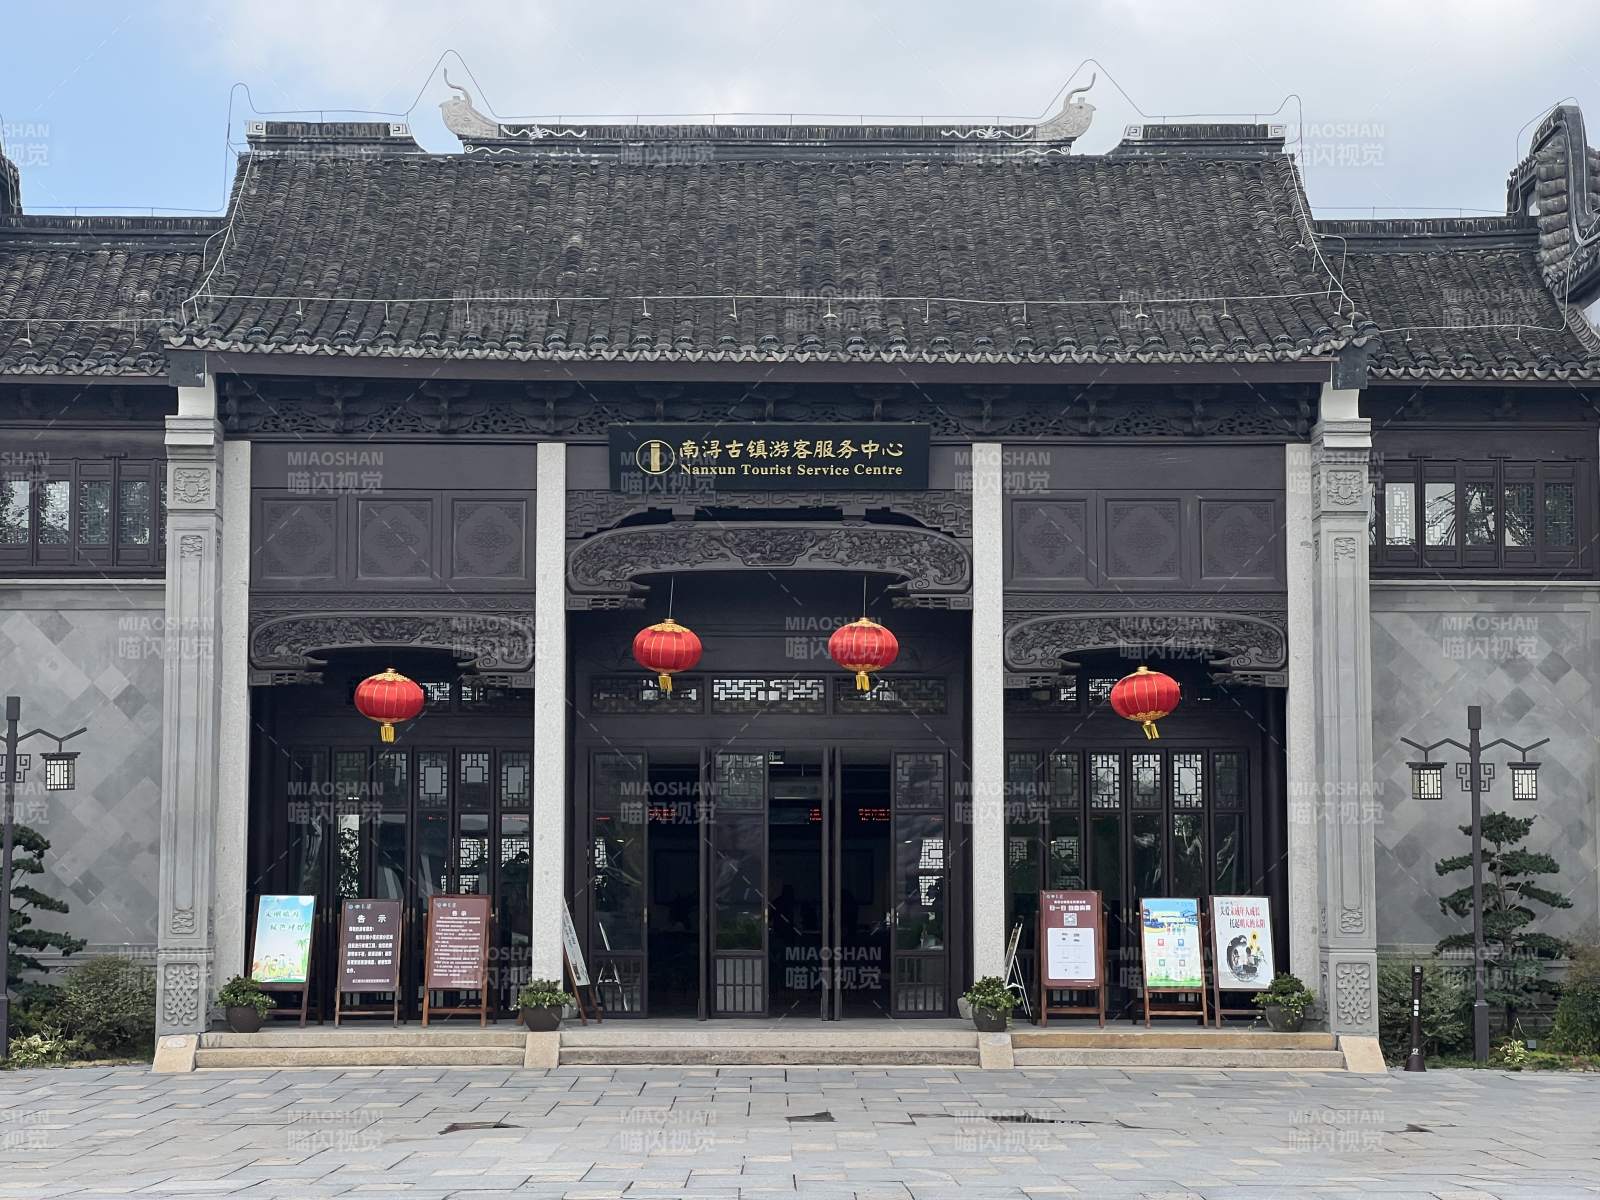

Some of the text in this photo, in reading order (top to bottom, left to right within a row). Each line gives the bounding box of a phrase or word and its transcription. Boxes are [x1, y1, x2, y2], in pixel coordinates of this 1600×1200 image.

[679, 439, 903, 459] 南浔古镇游客服务中心
[680, 464, 903, 476] Nanxun Tourist Service Centre
